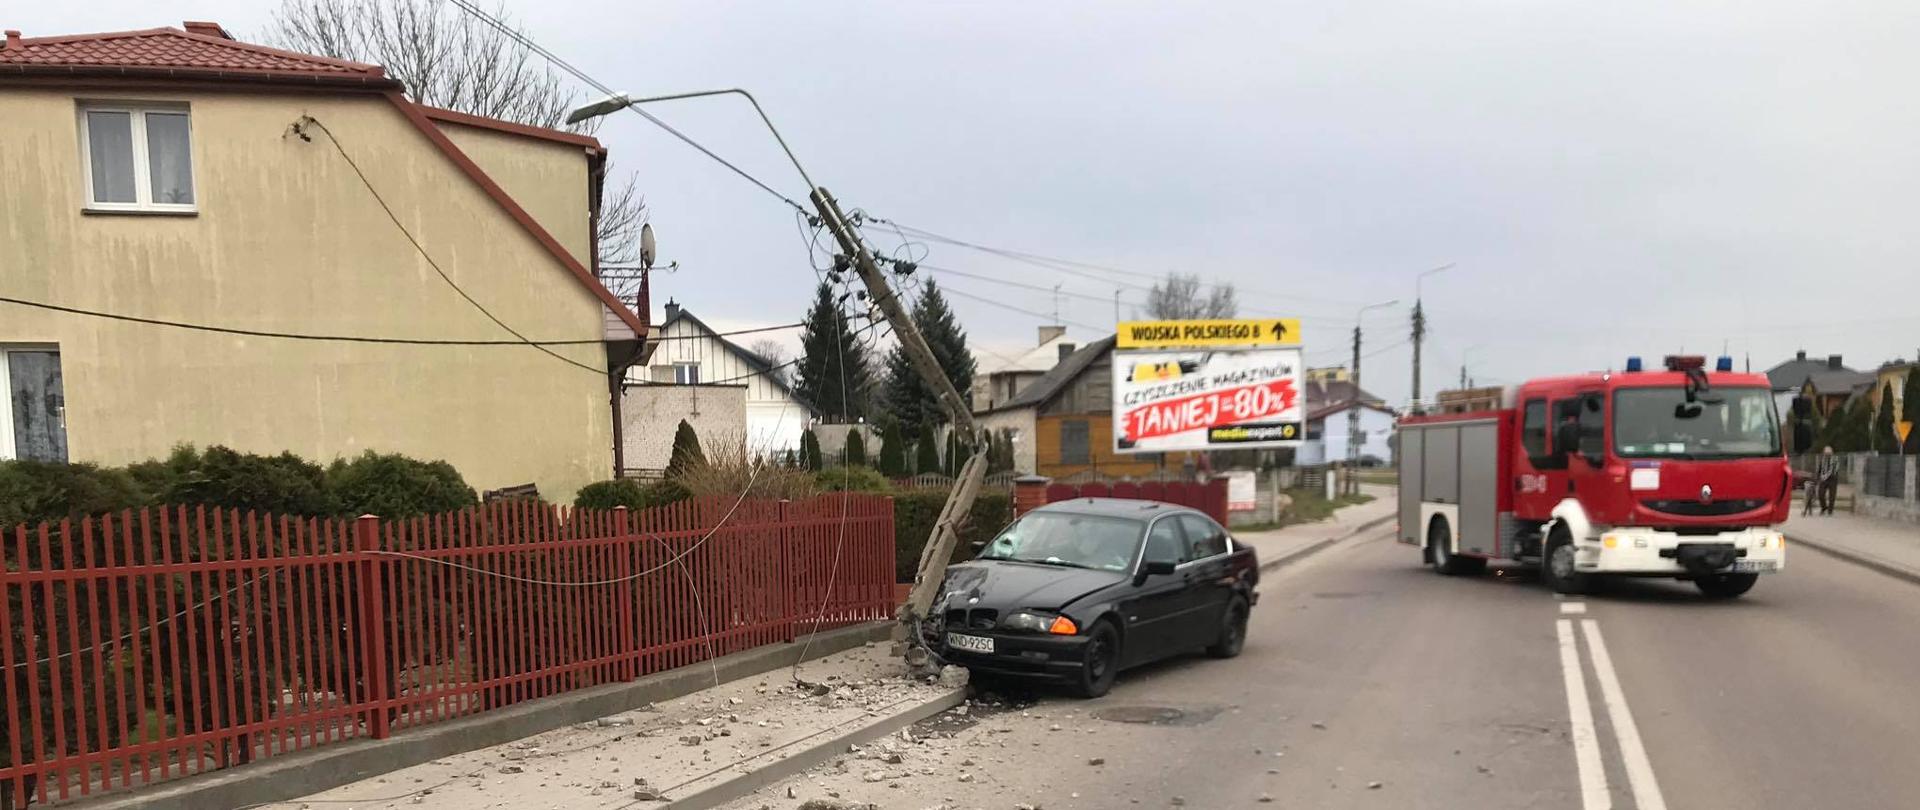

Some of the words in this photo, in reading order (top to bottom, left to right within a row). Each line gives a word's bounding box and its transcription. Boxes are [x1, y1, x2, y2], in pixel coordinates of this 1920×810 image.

[1131, 325, 1180, 341] WOJSKA
[1184, 324, 1250, 340] POLSKIEGO
[1252, 324, 1261, 338] 8
[1124, 376, 1208, 405] CZYSZCZENIE
[1135, 394, 1219, 436] TANIEJ
